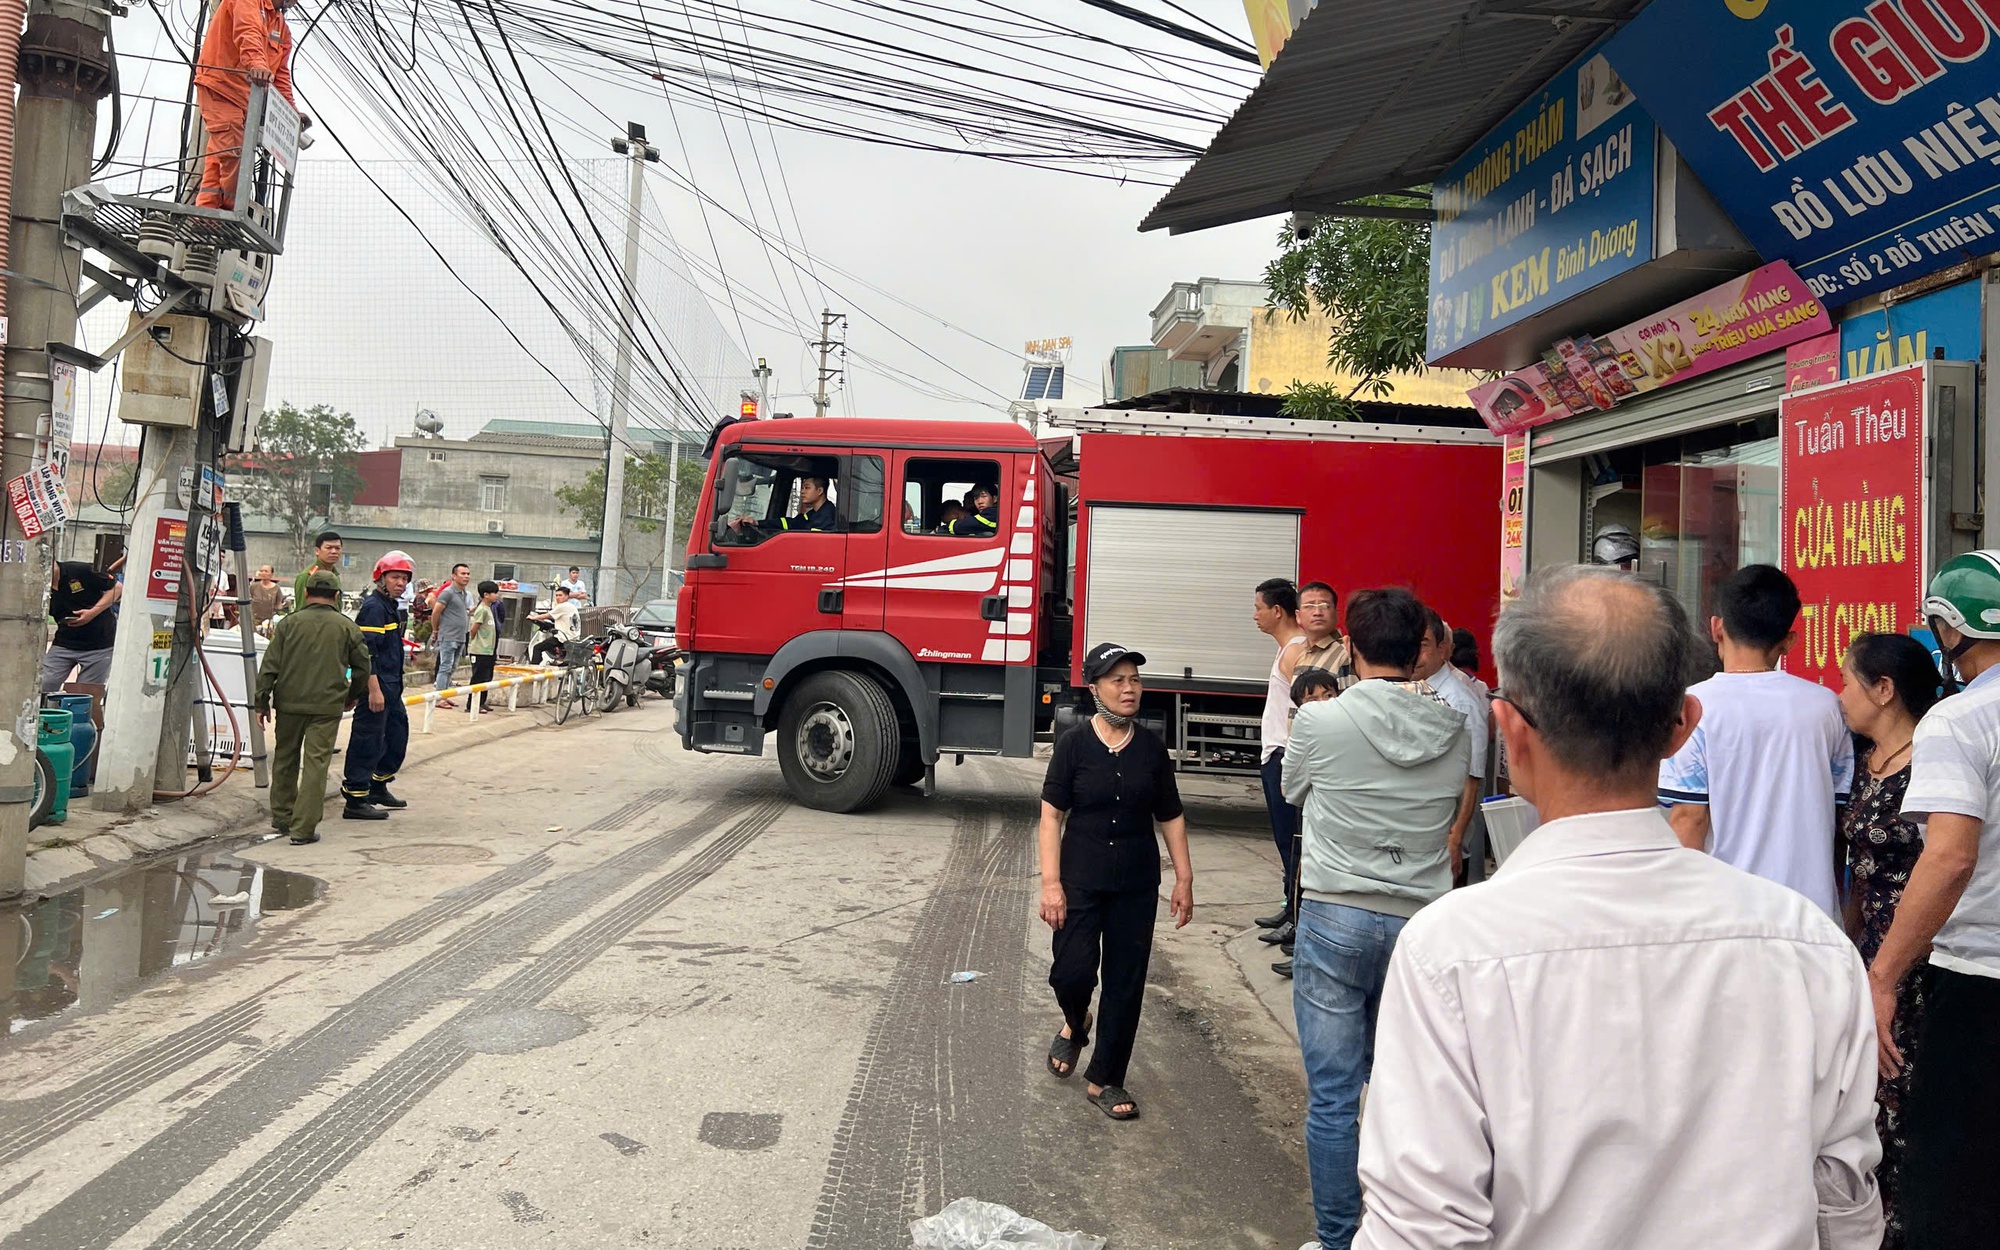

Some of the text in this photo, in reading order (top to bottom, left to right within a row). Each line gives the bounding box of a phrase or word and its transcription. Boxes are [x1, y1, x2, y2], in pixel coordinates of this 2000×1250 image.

[1706, 23, 1858, 173] THẾ
[1464, 148, 1512, 211] PHÒNG
[1515, 92, 1564, 174] PHẨM
[1497, 188, 1536, 249] LẠNH
[1551, 154, 1574, 214] ĐÁ
[1579, 123, 1632, 197] SẠCH
[1770, 176, 1834, 241] ĐỒ
[1823, 149, 1913, 217] LƯU
[1490, 218, 1638, 319] KEM Bình Dương
[1839, 252, 1872, 286] SỐ
[1869, 253, 1891, 275] 2
[1884, 233, 1922, 269] ĐỖ
[1916, 212, 1995, 255] THIÊN
[1689, 285, 1791, 337] 24 NĂM VÀNG
[1711, 329, 1745, 353] TRIỆU
[1747, 315, 1778, 341] QUÀ
[1774, 300, 1819, 328] SANG
[1640, 333, 1693, 379] X2
[1832, 351, 1837, 359] 2
[1847, 329, 1927, 378] VĂN
[1795, 399, 1906, 456] Tuấn Thêu
[9, 478, 40, 538] 0983.160.622
[44, 479, 58, 501] MẠNG
[51, 499, 64, 516] WIFI
[1843, 480, 1906, 567] HÀNG
[917, 647, 972, 659] Schlingmann
